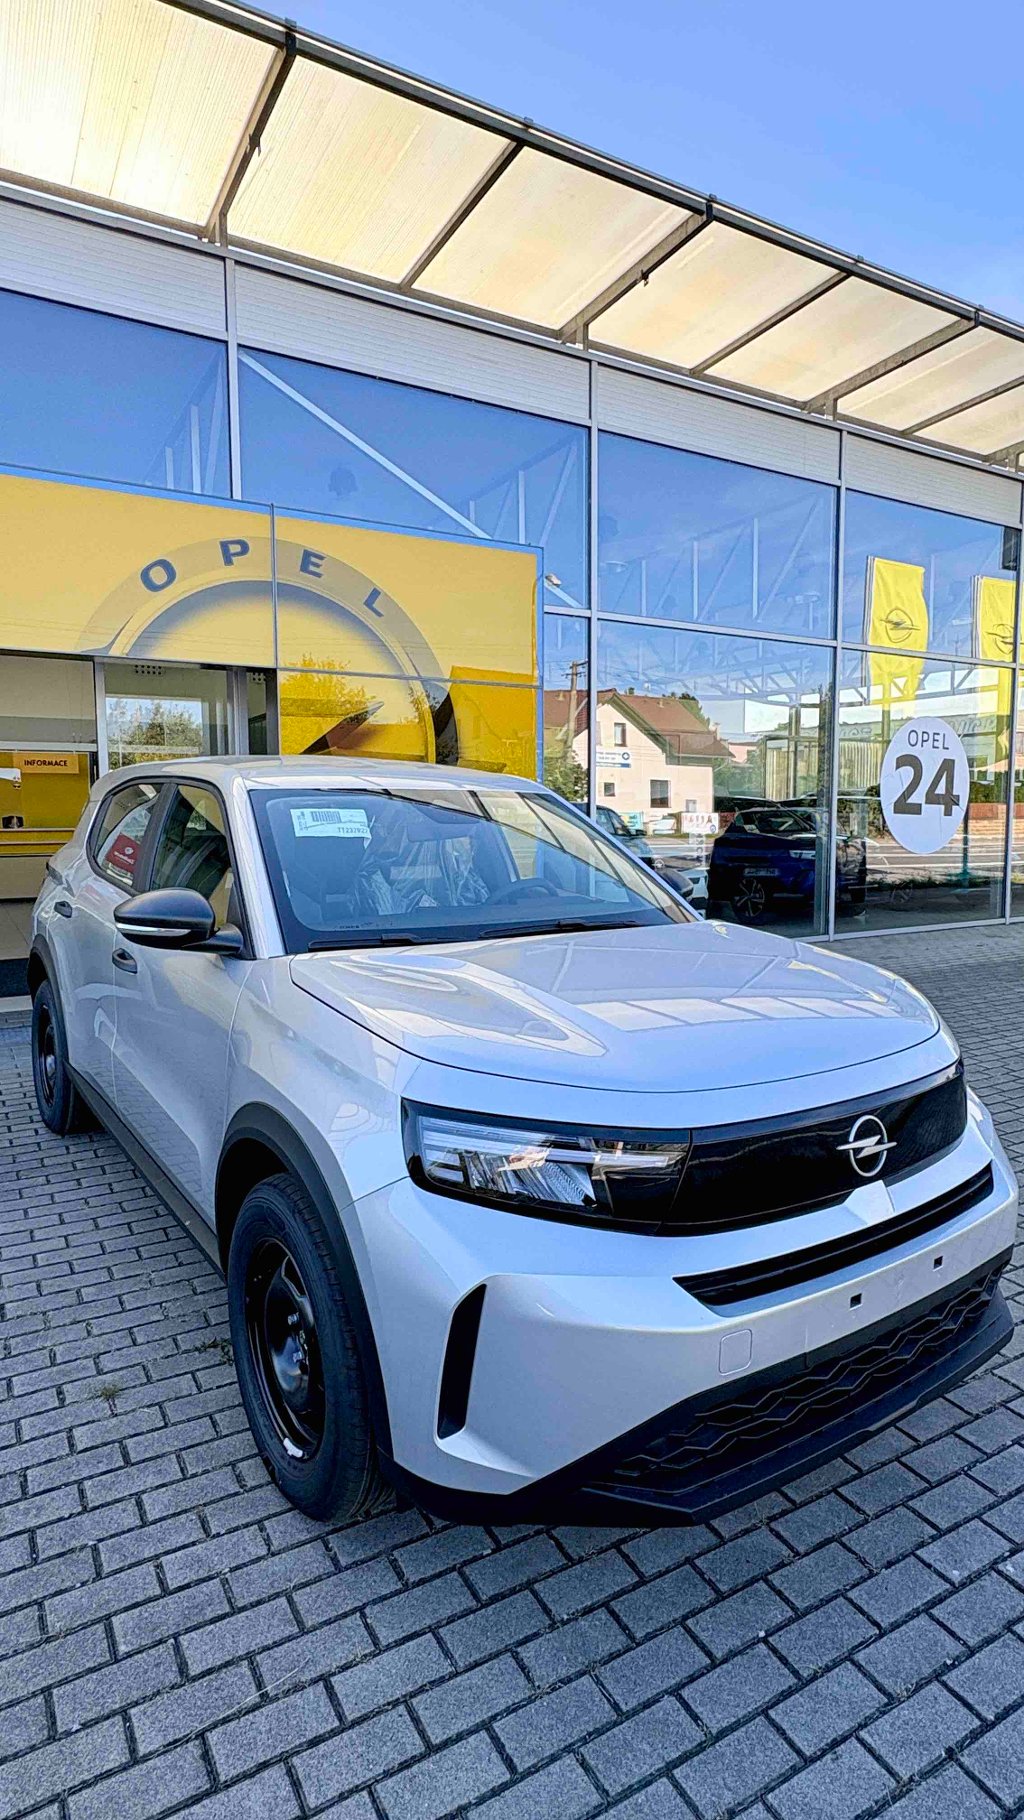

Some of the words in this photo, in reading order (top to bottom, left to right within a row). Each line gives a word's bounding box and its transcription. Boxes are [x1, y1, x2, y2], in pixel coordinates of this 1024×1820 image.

[139, 538, 384, 618] OPEL
[907, 729, 950, 750] OPEL
[24, 759, 68, 767] INFORMACE
[893, 753, 960, 817] 24
